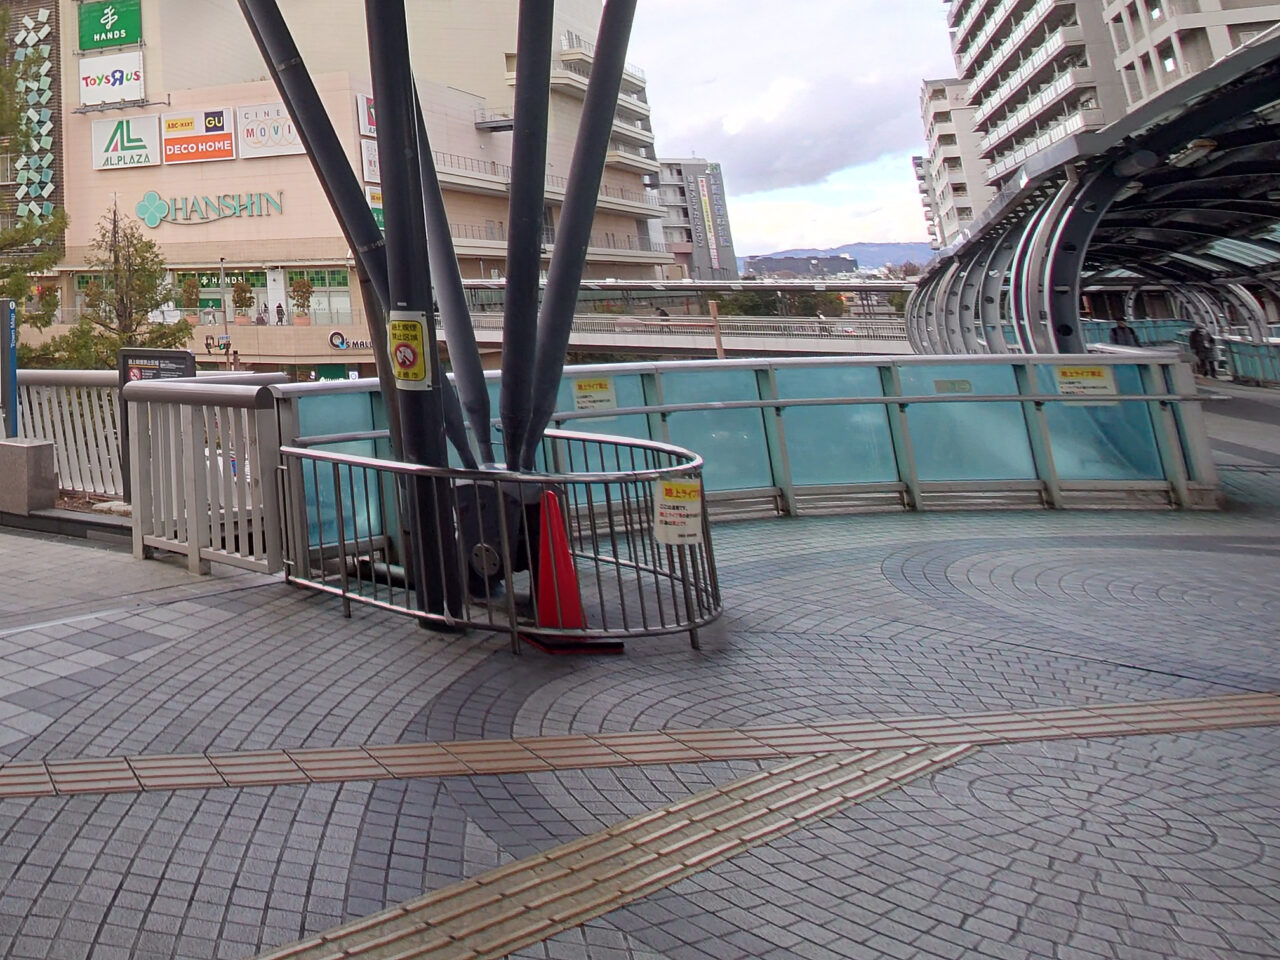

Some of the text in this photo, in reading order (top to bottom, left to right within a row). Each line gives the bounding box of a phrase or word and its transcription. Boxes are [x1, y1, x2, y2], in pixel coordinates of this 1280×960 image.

[93, 30, 126, 42] HANDS
[244, 110, 281, 120] CINE
[205, 116, 224, 129] GU
[246, 124, 291, 138] MOVI
[166, 140, 232, 155] DECO HOME
[102, 153, 151, 168] AL.PLAZA
[170, 191, 284, 222] HANSHIN
